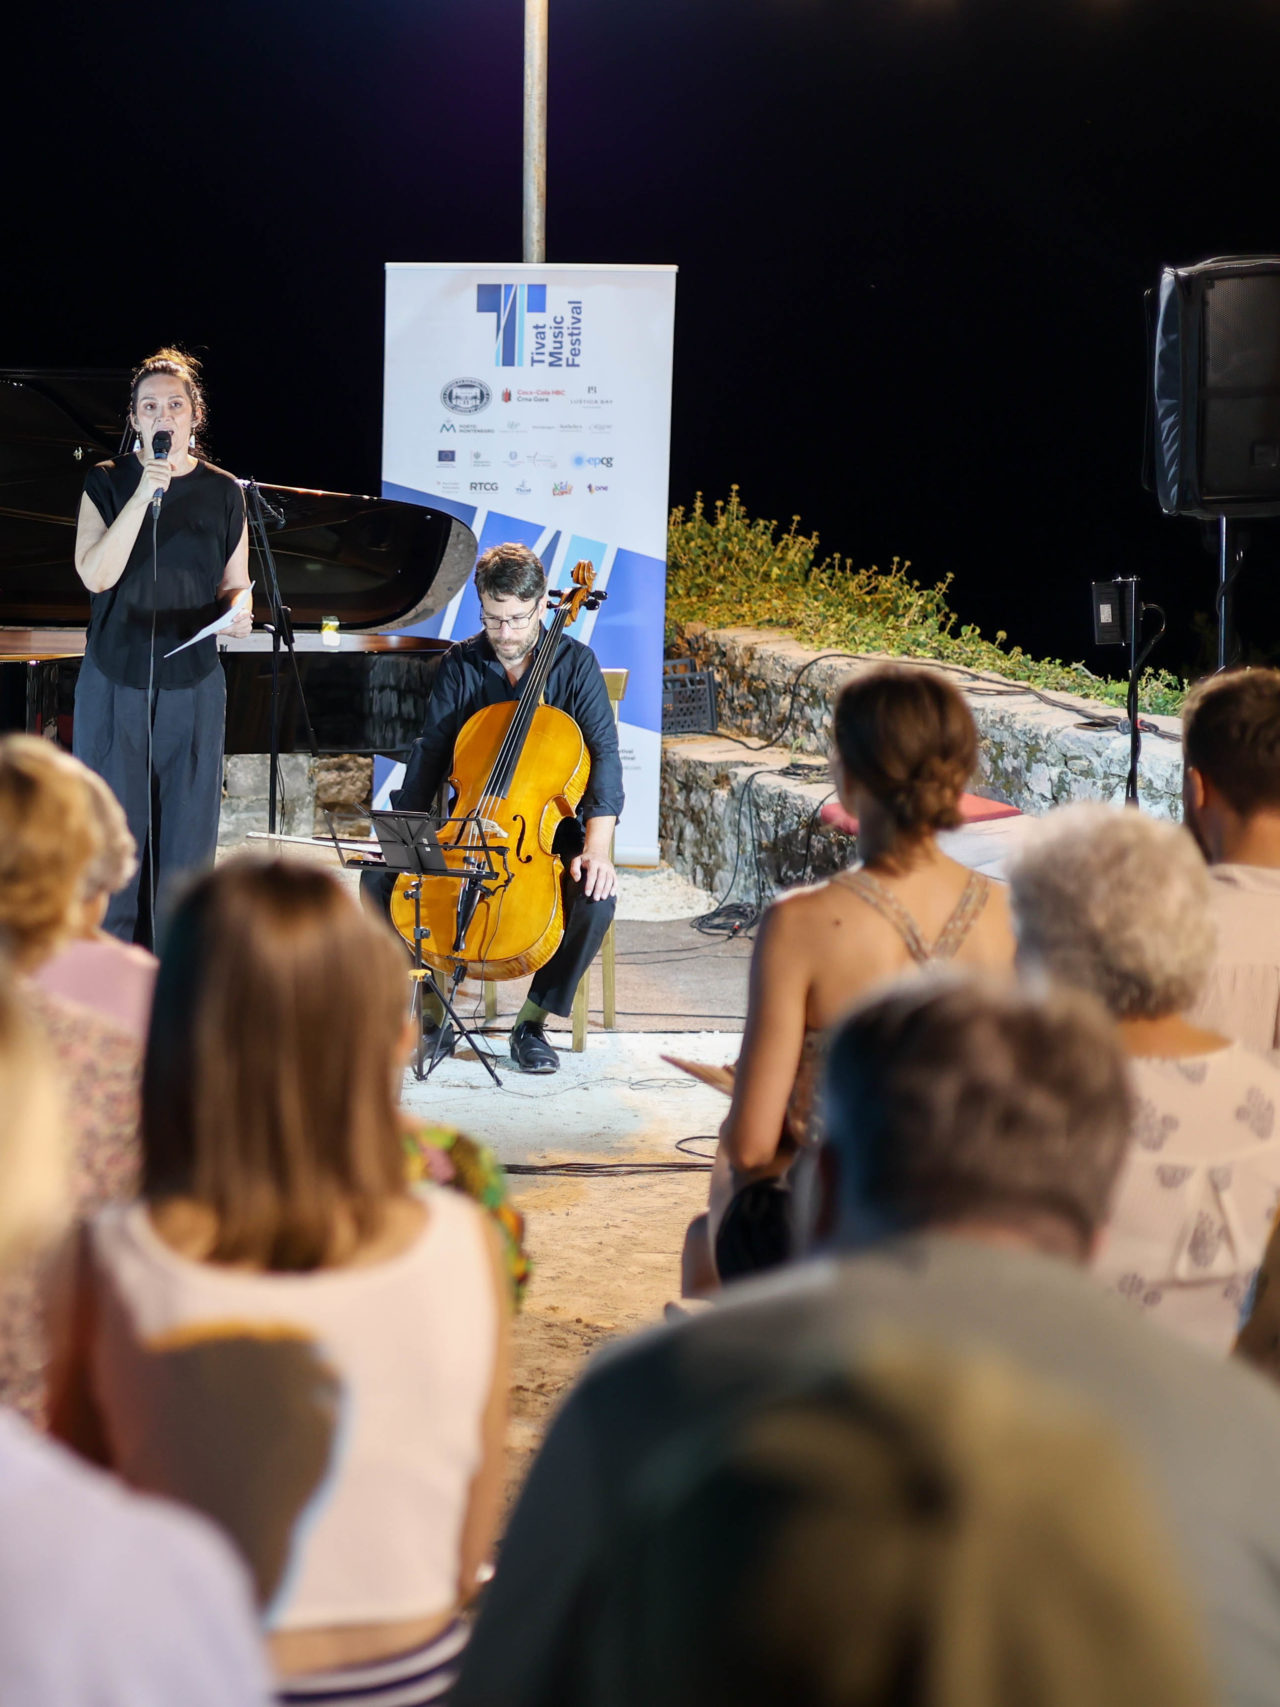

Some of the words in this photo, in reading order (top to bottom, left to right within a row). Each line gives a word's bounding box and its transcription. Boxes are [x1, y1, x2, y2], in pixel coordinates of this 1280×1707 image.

[530, 323, 547, 367] Tivat
[548, 315, 565, 367] Music
[565, 300, 582, 367] Festival
[470, 482, 499, 491] RTCG
